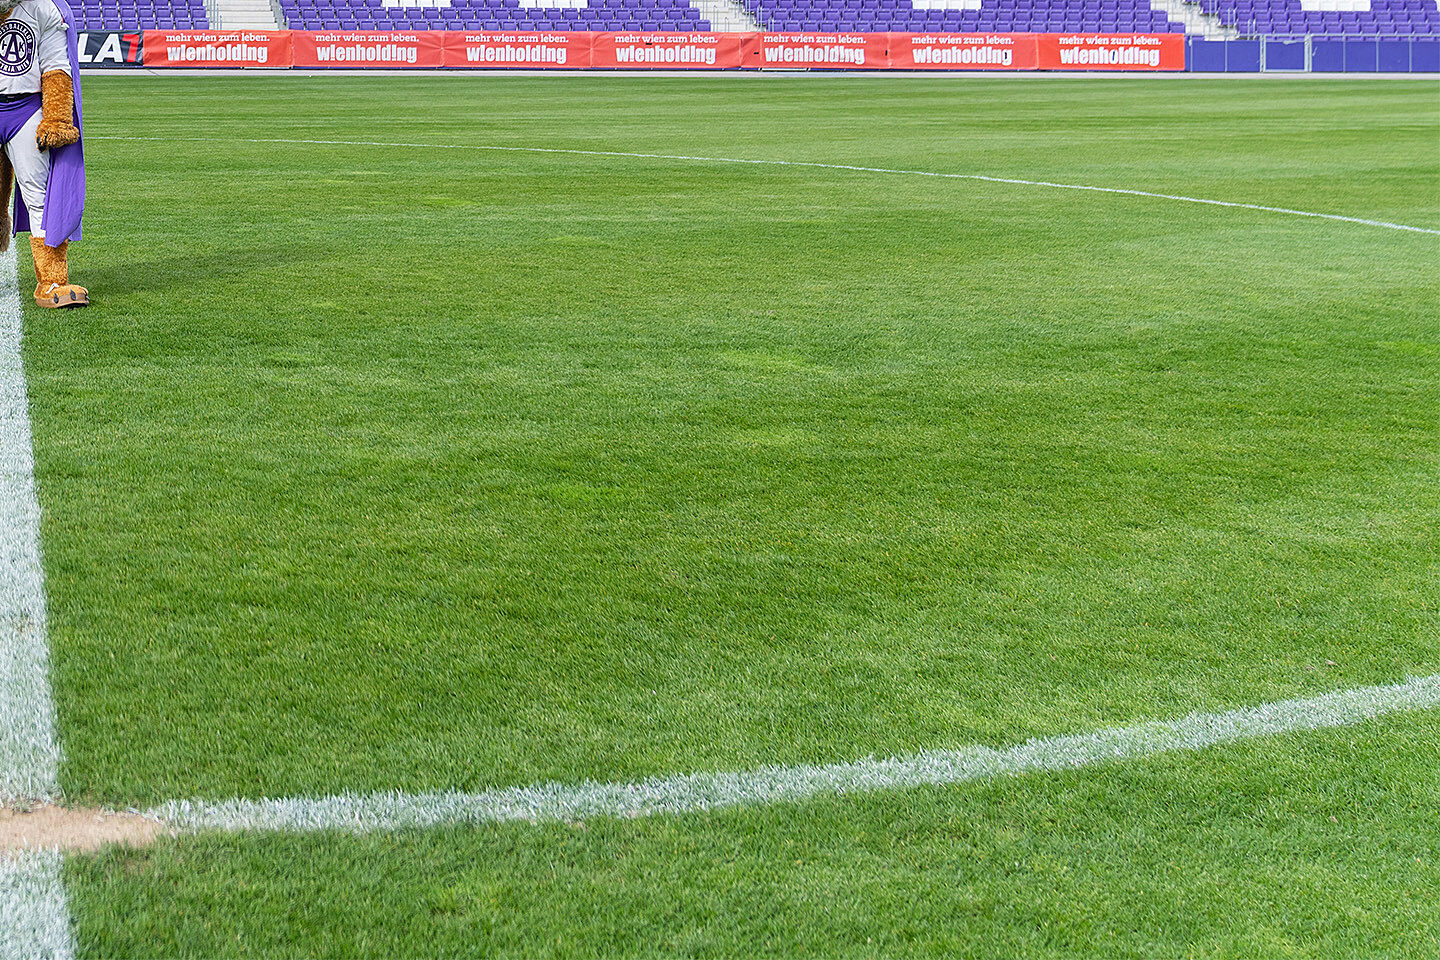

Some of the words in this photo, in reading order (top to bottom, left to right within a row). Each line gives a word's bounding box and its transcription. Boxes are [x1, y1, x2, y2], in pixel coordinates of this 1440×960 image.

[165, 33, 192, 42] mehr
[193, 33, 217, 42] wien
[241, 33, 270, 42] leben.
[315, 33, 342, 42] mehr
[343, 33, 367, 42] wien
[391, 33, 420, 42] leben.
[465, 33, 492, 42] mehr
[493, 33, 517, 42] wien
[541, 33, 570, 42] leben.
[614, 34, 641, 43] mehr
[642, 34, 666, 43] wien
[690, 34, 719, 43] leben.
[763, 34, 790, 43] mehr
[791, 34, 815, 43] wien
[839, 34, 868, 43] leben.
[911, 36, 938, 45] mehr
[939, 36, 963, 45] wien
[987, 36, 1016, 45] leben.
[1058, 36, 1085, 45] mehr
[1086, 36, 1110, 45] wien
[1134, 36, 1163, 45] leben.
